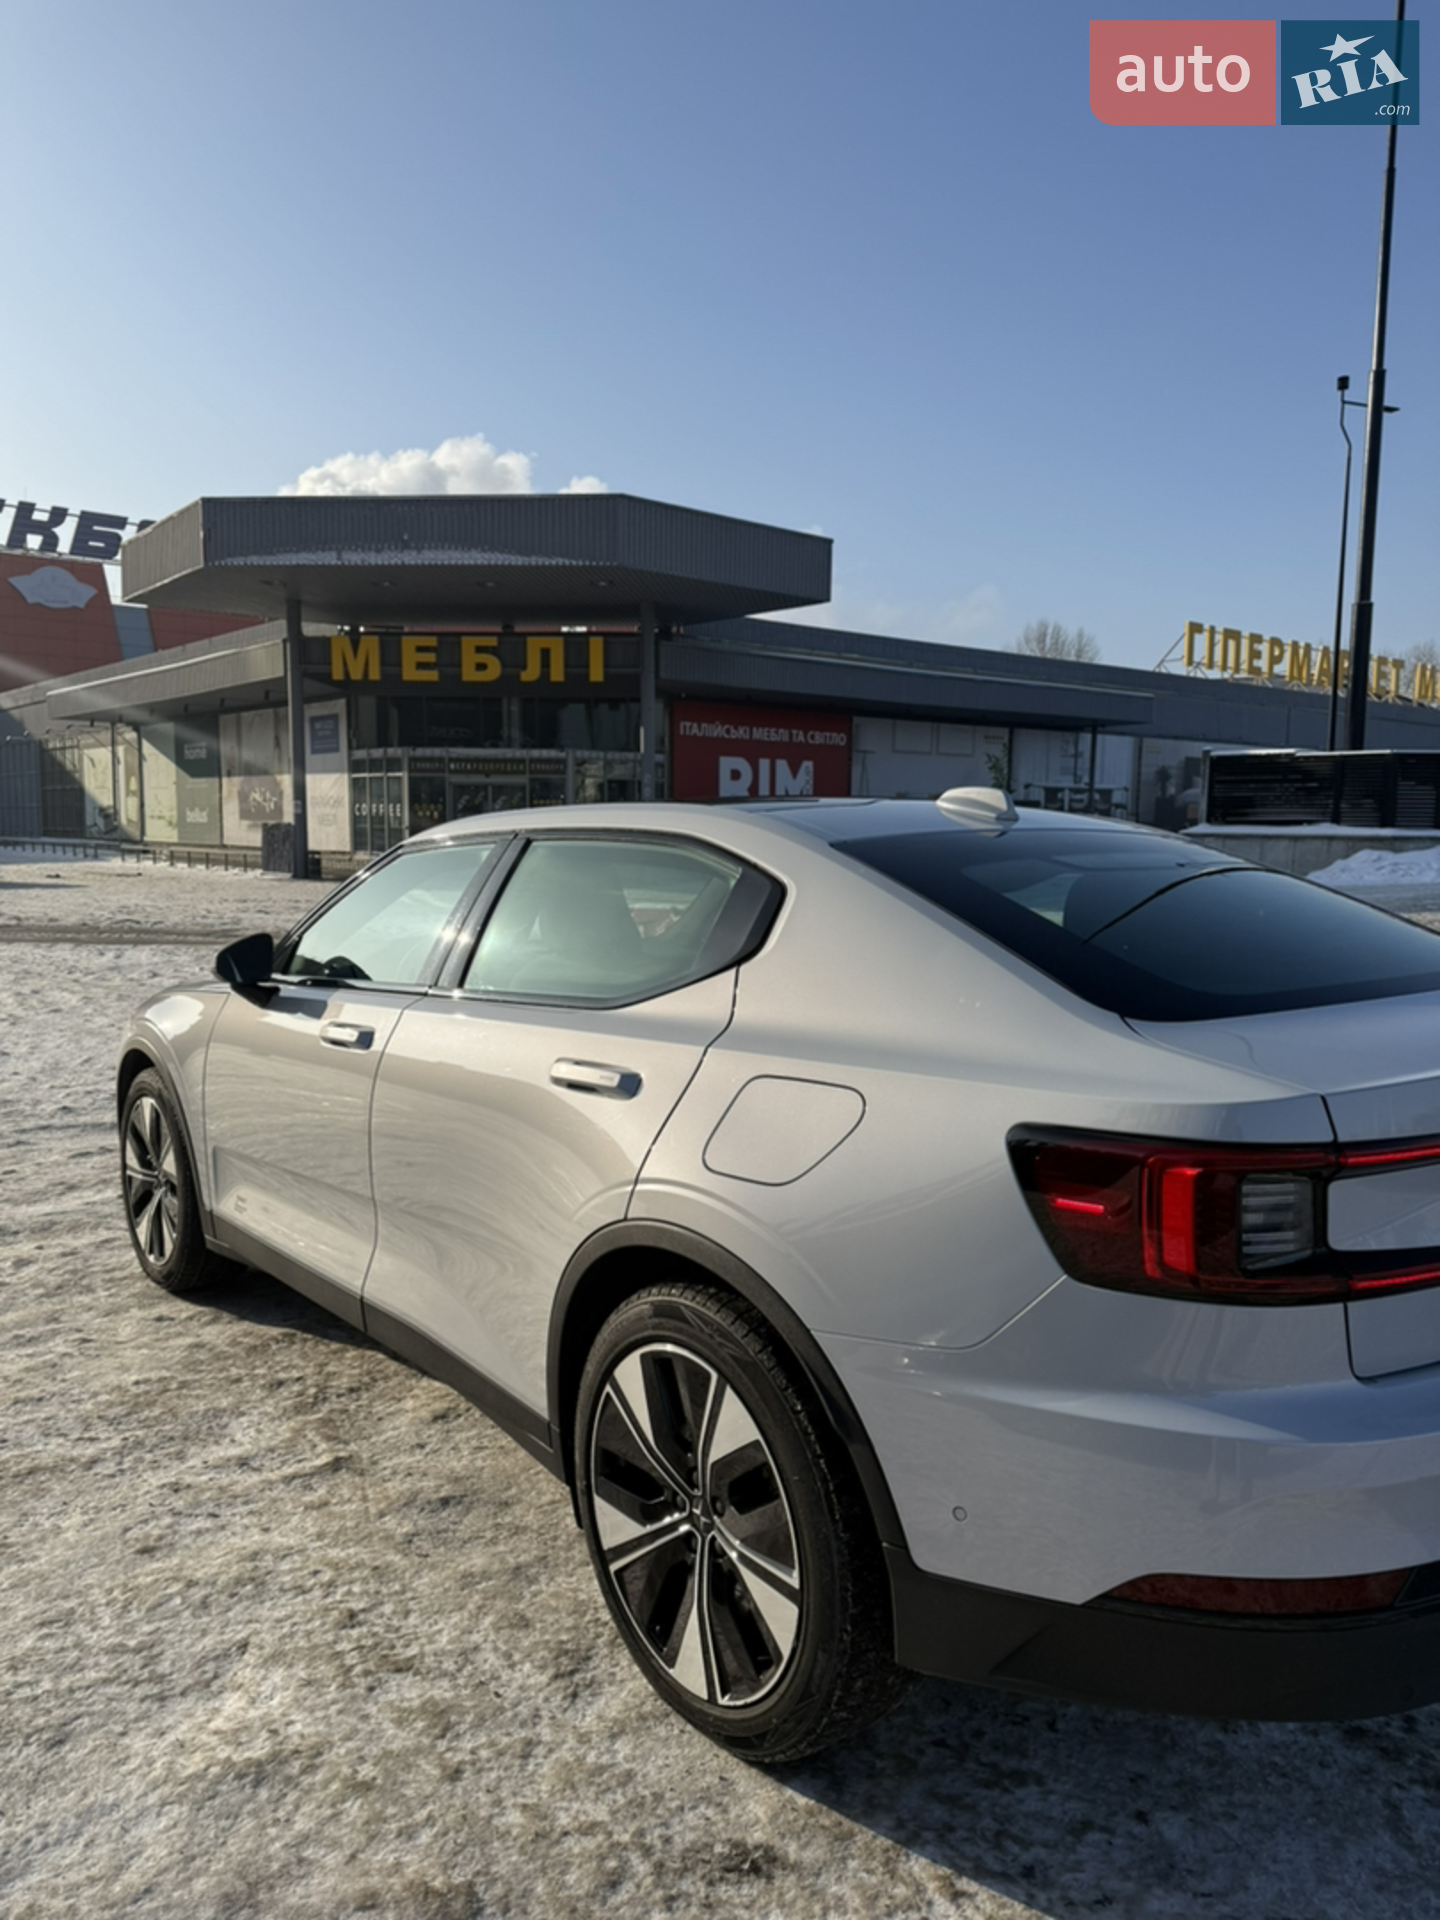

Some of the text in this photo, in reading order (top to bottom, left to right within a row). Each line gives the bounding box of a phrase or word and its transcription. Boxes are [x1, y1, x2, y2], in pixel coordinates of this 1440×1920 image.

[330, 635, 605, 682] МЕБЛІ
[1183, 621, 1405, 696] ГІПЕРМАРЕТ
[679, 721, 847, 746] ІТАЛІЙСЬКІ МЕБЛІ ТА СВІТЛО
[354, 803, 402, 817] COFFEE
